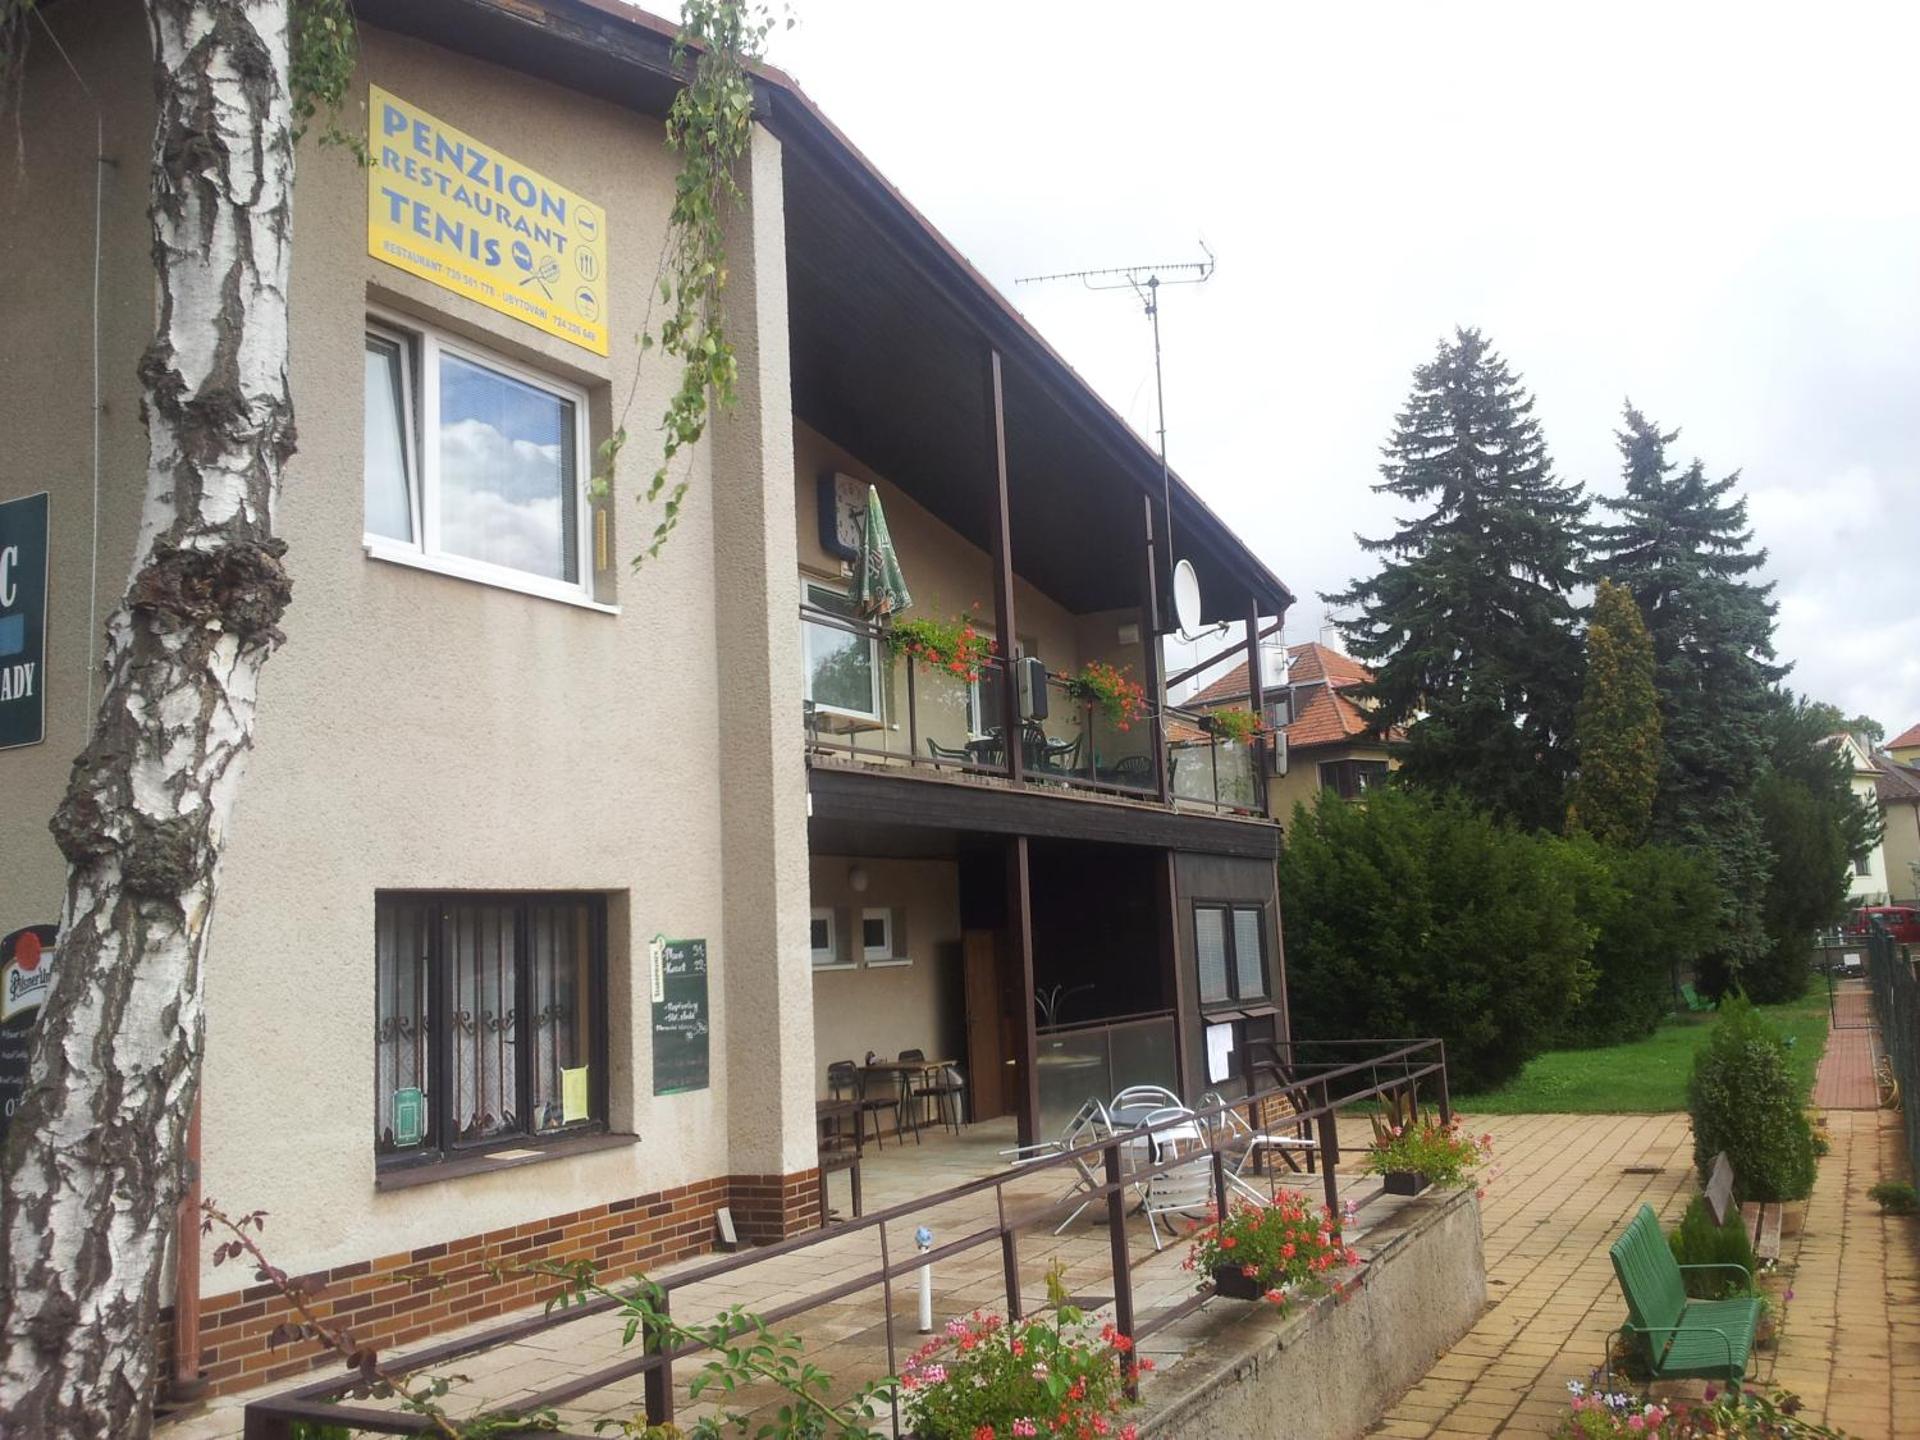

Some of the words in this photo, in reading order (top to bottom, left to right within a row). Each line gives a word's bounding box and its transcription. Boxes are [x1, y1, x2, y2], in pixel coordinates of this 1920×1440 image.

[382, 145, 568, 254] RESTAURANT
[383, 103, 566, 226] PENZION
[381, 186, 501, 266] TENIS
